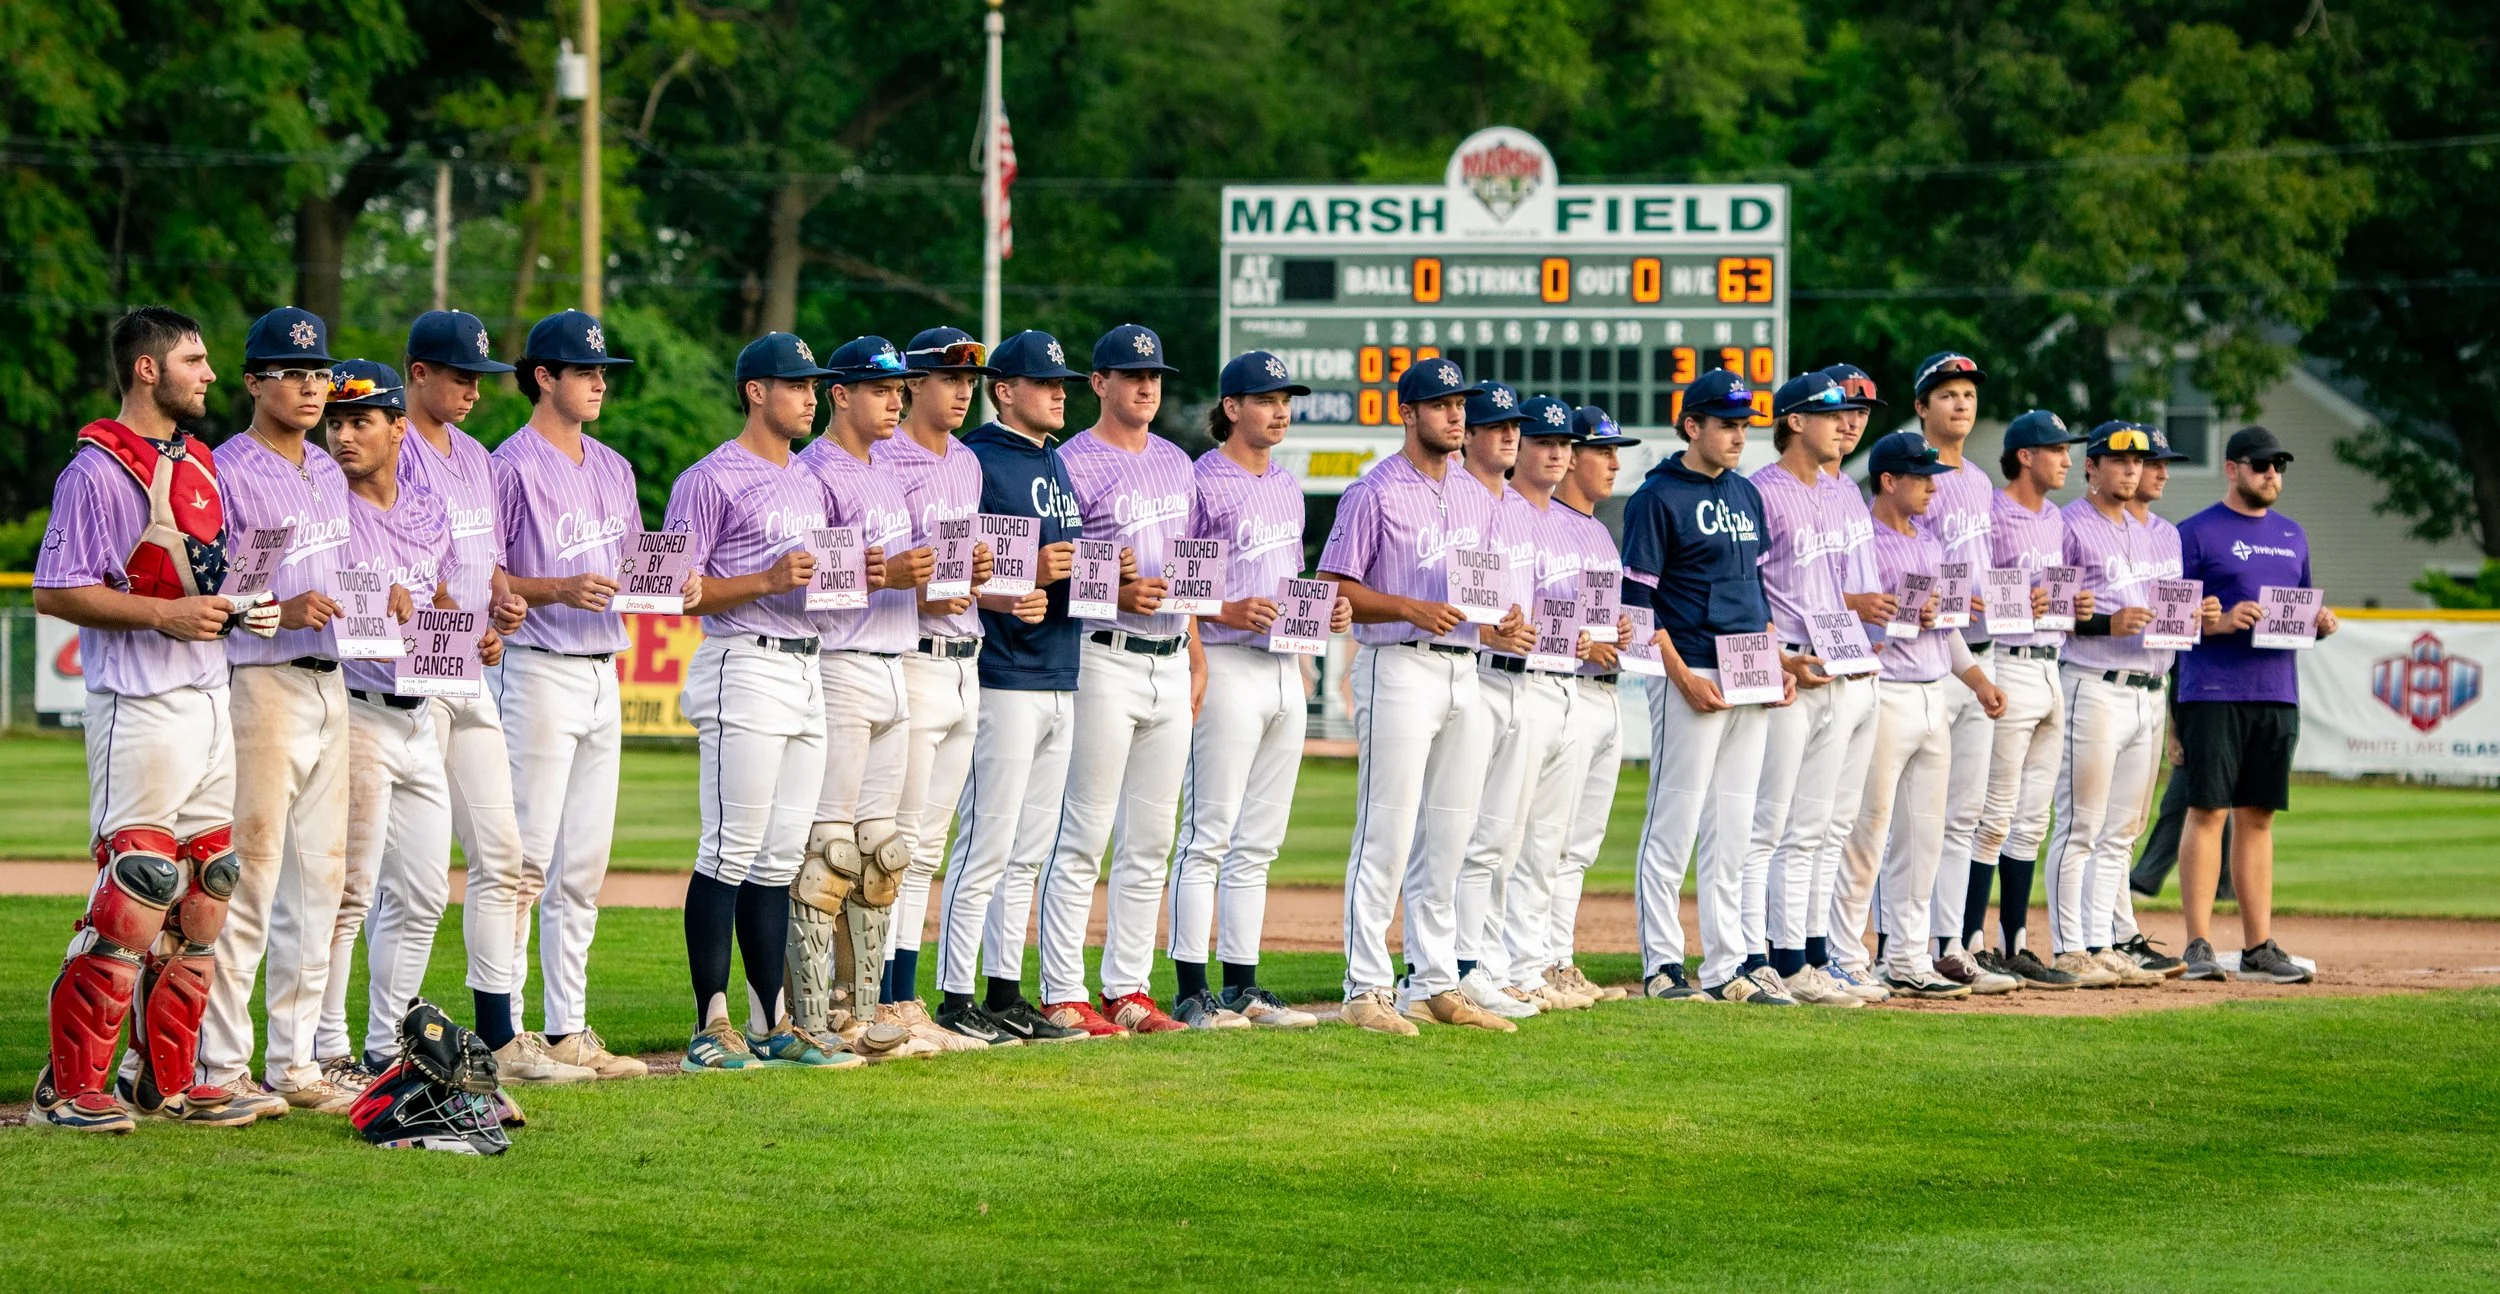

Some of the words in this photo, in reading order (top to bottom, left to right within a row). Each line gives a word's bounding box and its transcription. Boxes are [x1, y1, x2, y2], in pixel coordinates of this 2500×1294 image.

[1231, 198, 1445, 234] MARSH
[1557, 198, 1774, 233] FIELD
[1239, 256, 1273, 278] AT
[1345, 267, 1411, 295] BALL
[1413, 258, 1442, 303] 0
[1447, 267, 1540, 295] STRIKE
[1542, 258, 1570, 303] 0
[1577, 267, 1631, 295] OUT
[1632, 258, 1661, 303] 0
[1671, 266, 1716, 295] H/E
[1718, 257, 1773, 303] 63
[1232, 279, 1281, 305] BAT
[1364, 320, 1378, 344] 1
[1391, 320, 1408, 344] 2
[1419, 320, 1436, 344] 3
[1448, 320, 1465, 344] 4
[1476, 320, 1493, 344] 5
[1504, 320, 1522, 344] 6
[1533, 320, 1551, 344] 7
[1562, 320, 1580, 344] 8
[1591, 320, 1609, 344] 9
[1665, 320, 1684, 344] R
[1713, 320, 1732, 344] H
[1753, 320, 1770, 344] E
[1359, 346, 1383, 383] 0
[1672, 347, 1696, 384] 3
[1750, 347, 1774, 383] 0
[1359, 389, 1383, 426] 0
[556, 507, 628, 549] Clippers
[940, 520, 970, 540] TOUCHED
[980, 516, 1029, 537] TOUCHED
[1236, 514, 1301, 551] Clippers
[251, 529, 288, 550] TOUCHED
[637, 533, 686, 554] TOUCHED
[812, 528, 854, 549] TOUCHED
[997, 537, 1011, 556] BY
[947, 541, 958, 559] BY
[1080, 541, 1113, 561] TOUCHED
[1174, 540, 1218, 559] TOUCHED
[2252, 544, 2275, 556] Trinity
[255, 551, 271, 571] BY
[647, 554, 664, 573] BY
[830, 550, 842, 569] BY
[992, 559, 1023, 577] ANCER
[1187, 560, 1201, 577] BY
[1456, 549, 1500, 571] TOUCHED
[820, 570, 855, 590] CANCER
[936, 561, 964, 580] CANCER
[1089, 562, 1099, 580] BY
[1472, 570, 1485, 587] BY
[1586, 571, 1614, 589] TOUCHED
[1940, 564, 1968, 579] TOUCHED
[1987, 571, 2022, 585] TOUCHED
[2047, 568, 2076, 583] TOUCHED
[336, 571, 381, 592] TOUCHED
[629, 575, 673, 594] CANCER
[1079, 582, 1108, 600] CANCER
[1174, 579, 1211, 598] CANCER
[1288, 580, 1329, 600] TOUCHED
[1904, 574, 1931, 591] TOUCHED
[1949, 581, 1958, 595] BY
[2053, 584, 2062, 598] BY
[355, 594, 367, 614] BY
[1461, 587, 1499, 607] CANCER
[1595, 590, 1604, 606] BY
[1906, 591, 1916, 606] BY
[2001, 587, 2011, 602] BY
[2158, 587, 2192, 603] TOUCHED
[2271, 589, 2313, 605] TOUCHED
[1173, 599, 1199, 610] Dad
[1298, 600, 1312, 617] BY
[1543, 599, 1575, 618] TOUCHED
[1941, 597, 1964, 612] CANCER
[1994, 604, 2023, 618] CANCER
[2167, 604, 2177, 618] BY
[2282, 605, 2296, 619] BY
[417, 611, 474, 632] TOUCHED
[1586, 608, 1611, 625] CANCER
[1812, 613, 1853, 630] TOUCHED
[347, 617, 386, 637] CANCER
[1284, 618, 1319, 637] CANCER
[1552, 619, 1562, 635] BY
[2156, 620, 2184, 634] CANCER
[2269, 620, 2305, 634] CANCER
[432, 634, 450, 653] BY
[1540, 637, 1569, 655] CANCER
[1726, 635, 1768, 653] TOUCHED
[1832, 630, 1845, 644] BY
[1743, 653, 1755, 669] BY
[1828, 644, 1865, 660] CANCER
[414, 655, 463, 676] CANCER
[1733, 671, 1769, 688] CANCER
[2347, 738, 2397, 753] WHITE
[2406, 740, 2445, 756] LAKE
